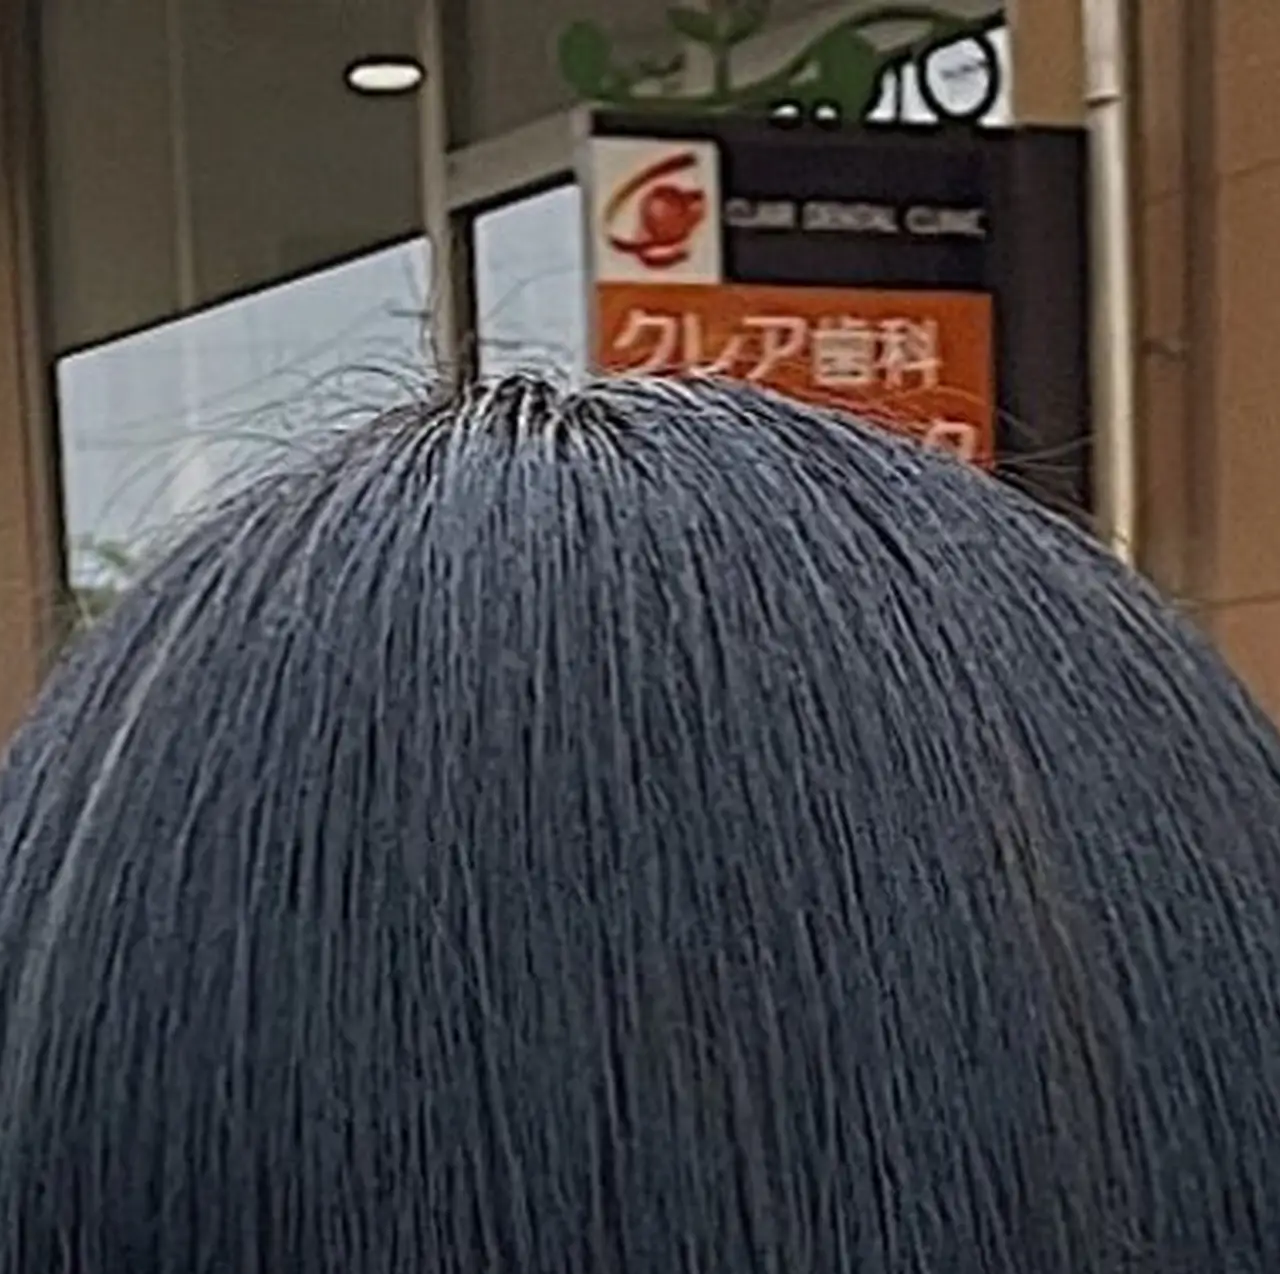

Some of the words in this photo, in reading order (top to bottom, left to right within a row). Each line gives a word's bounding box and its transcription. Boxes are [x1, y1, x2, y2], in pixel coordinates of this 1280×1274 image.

[613, 310, 943, 389] クレア歯科
